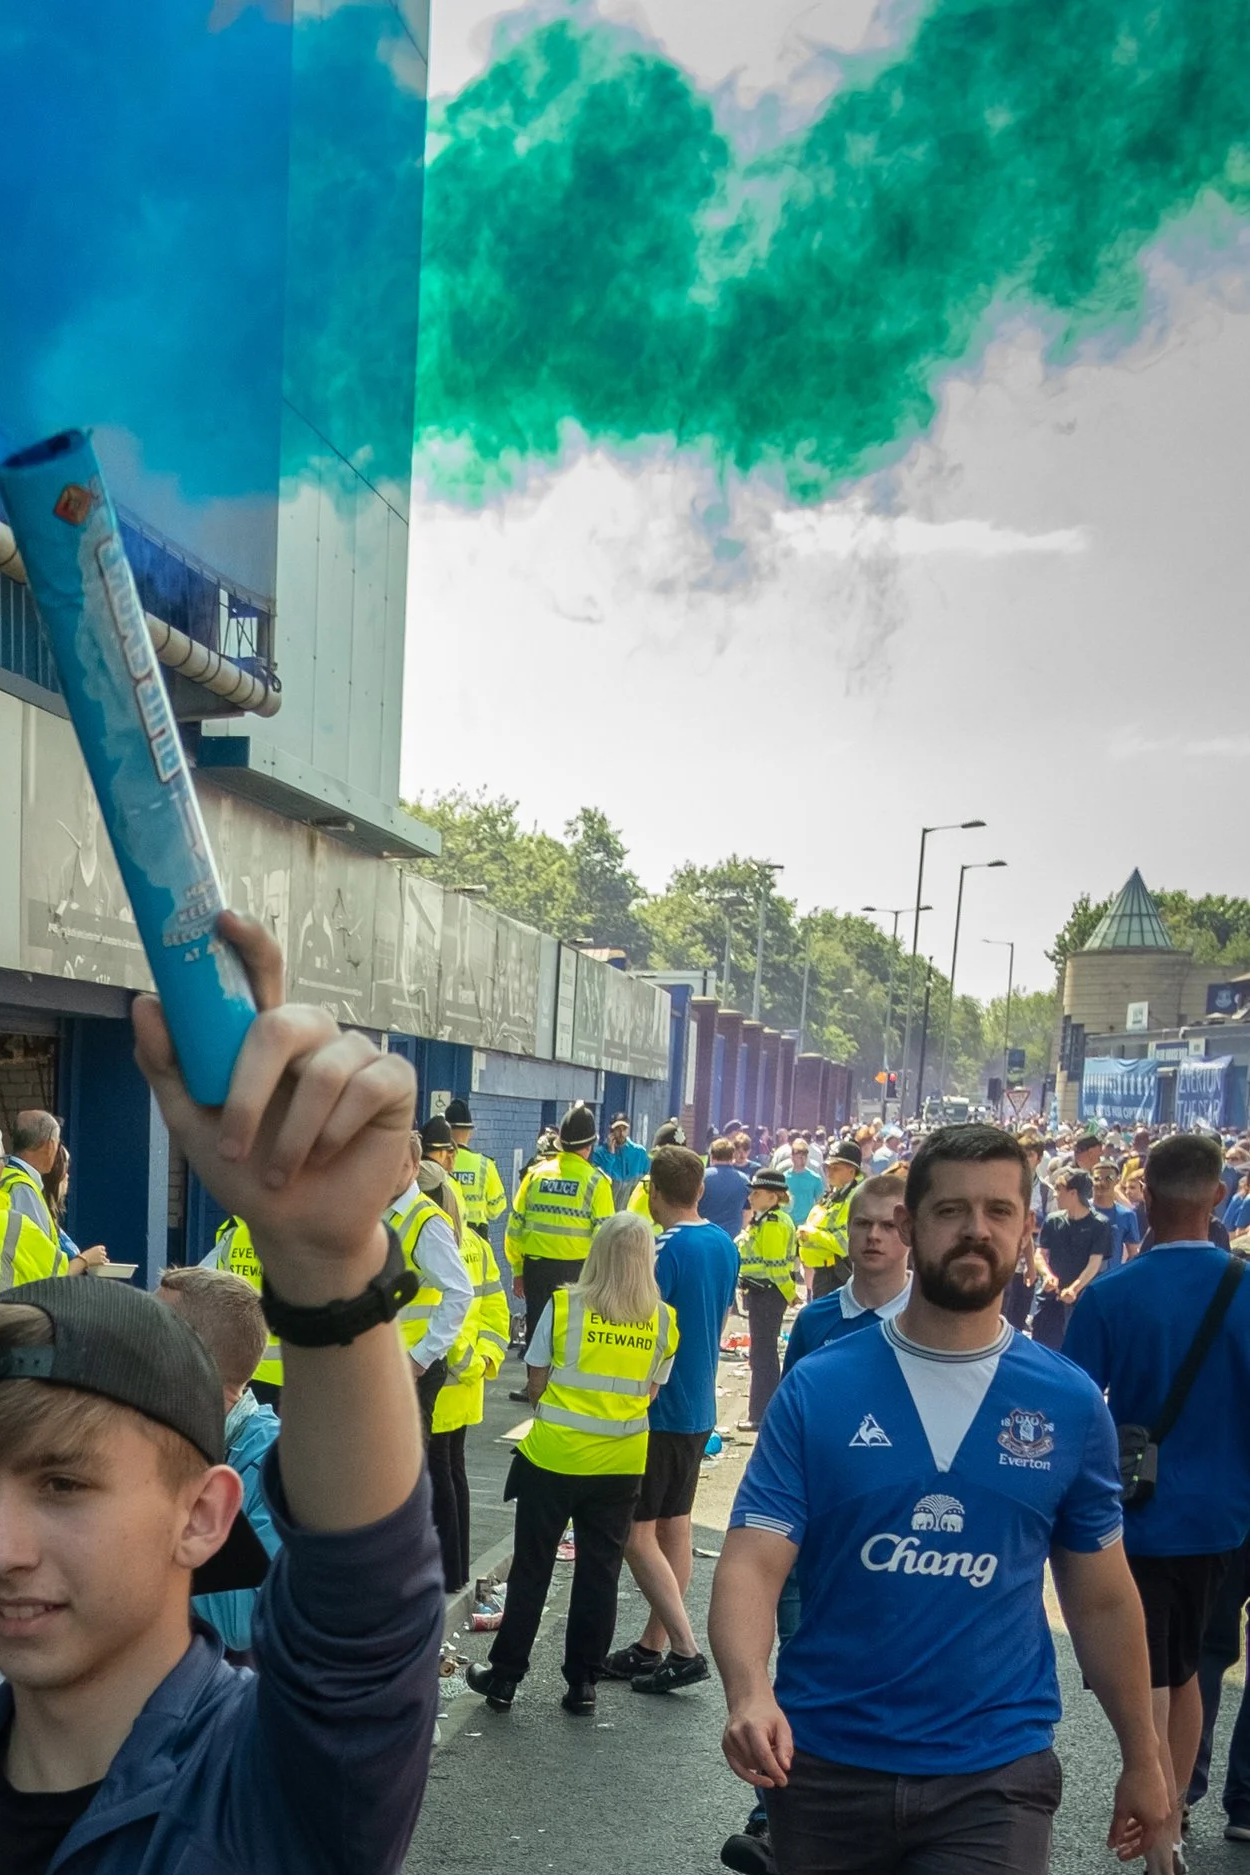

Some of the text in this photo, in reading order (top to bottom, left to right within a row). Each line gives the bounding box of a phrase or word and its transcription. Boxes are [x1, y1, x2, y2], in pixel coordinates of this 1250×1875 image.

[455, 1172, 475, 1184] LICE
[541, 1180, 578, 1195] POLICE
[231, 1247, 256, 1258] EVE
[587, 1331, 653, 1351] STEWARD
[998, 1453, 1051, 1471] Everton
[860, 1532, 998, 1588] Chang
